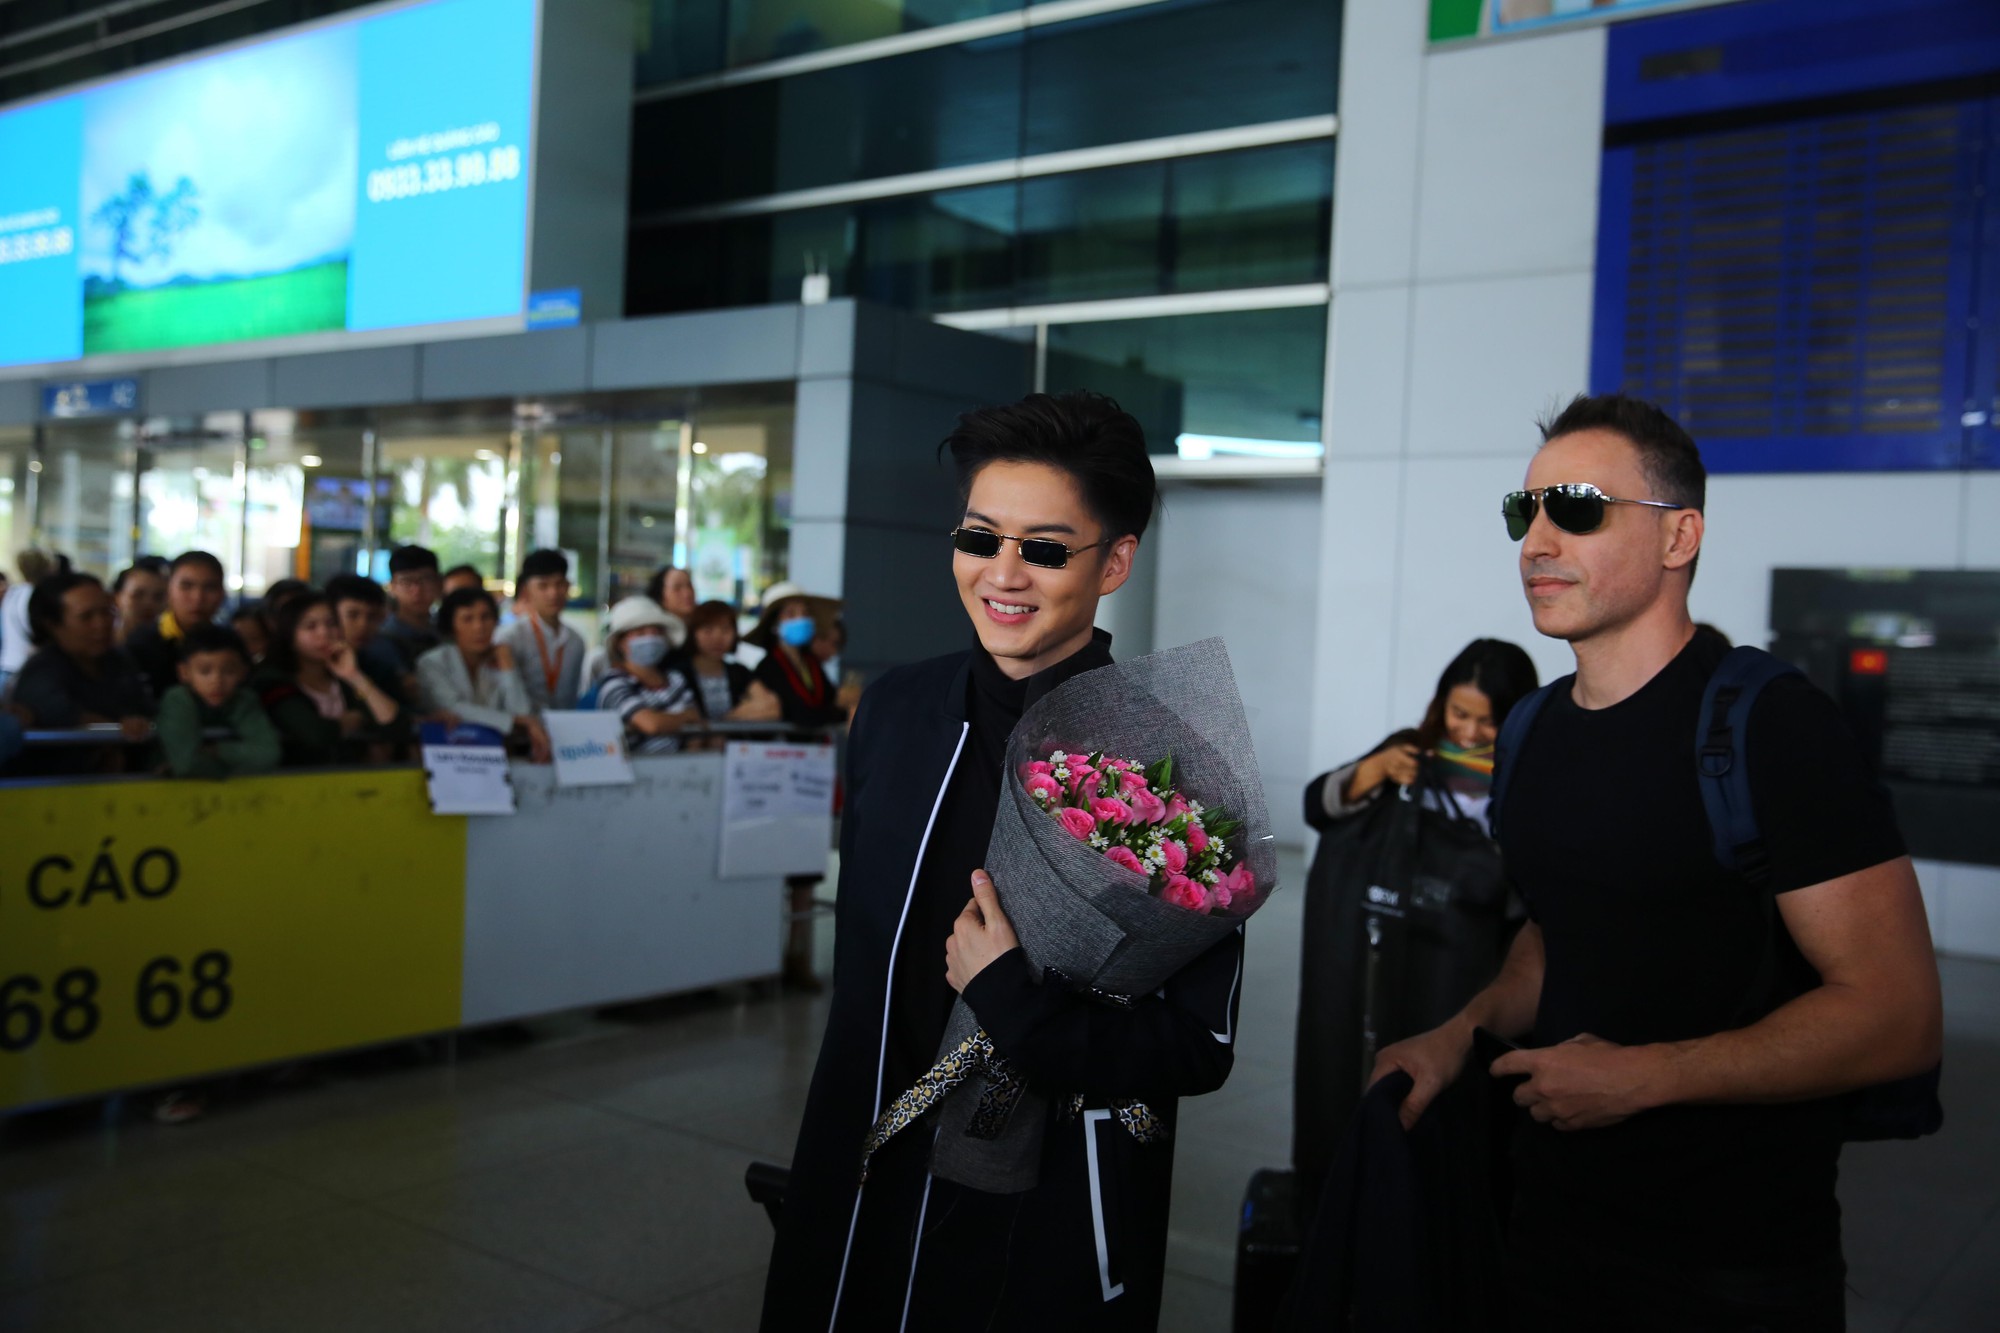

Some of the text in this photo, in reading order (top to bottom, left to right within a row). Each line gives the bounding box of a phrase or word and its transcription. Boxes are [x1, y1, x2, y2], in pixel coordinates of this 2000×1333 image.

[26, 835, 181, 910] CÁO
[0, 948, 234, 1053] 68 68
